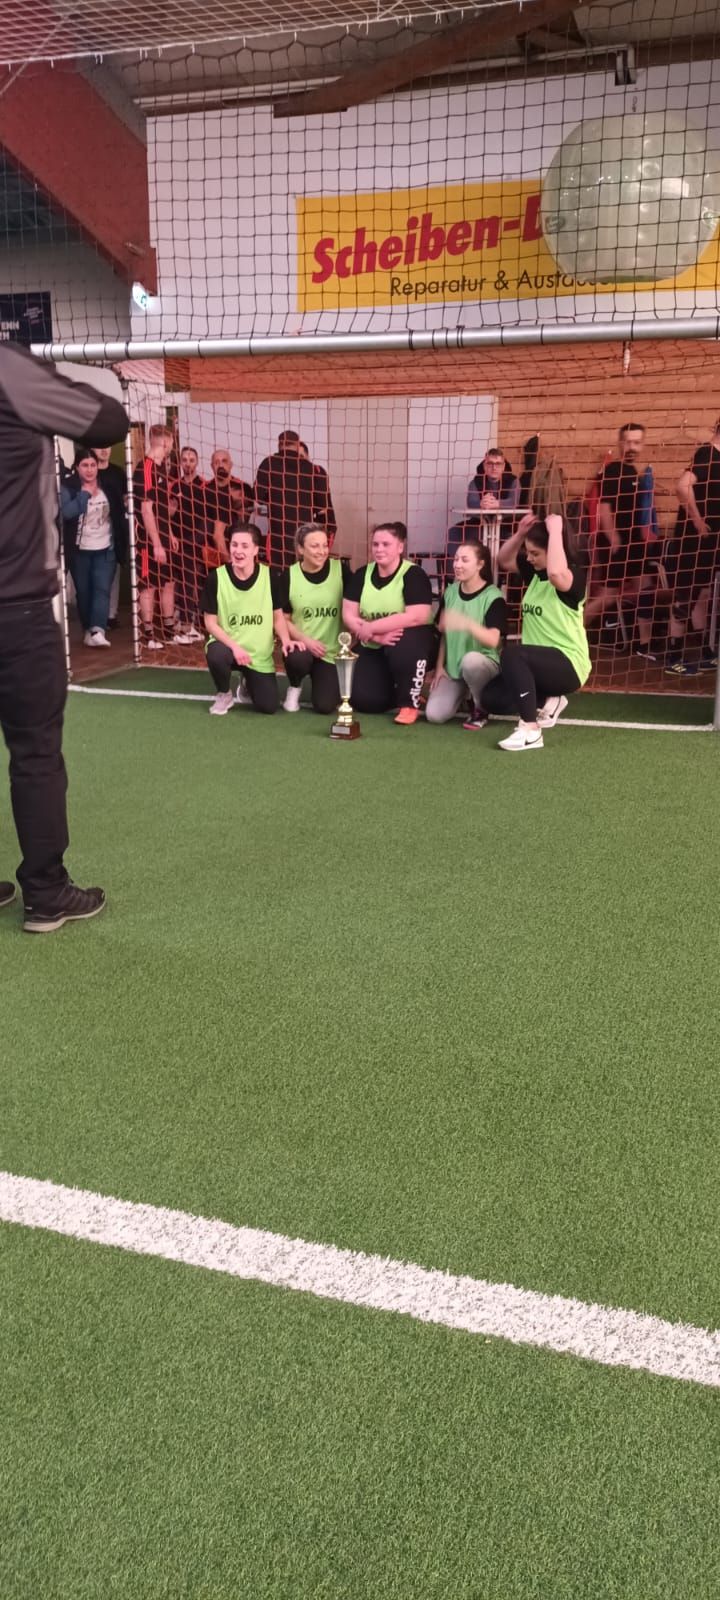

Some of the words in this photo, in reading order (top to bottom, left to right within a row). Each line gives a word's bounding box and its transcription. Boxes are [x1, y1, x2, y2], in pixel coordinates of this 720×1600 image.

[311, 193, 544, 284] Scheiben-D
[390, 275, 487, 299] Reparatur
[494, 269, 510, 291] &
[239, 614, 263, 626] JAKO
[314, 607, 338, 618] JAKO
